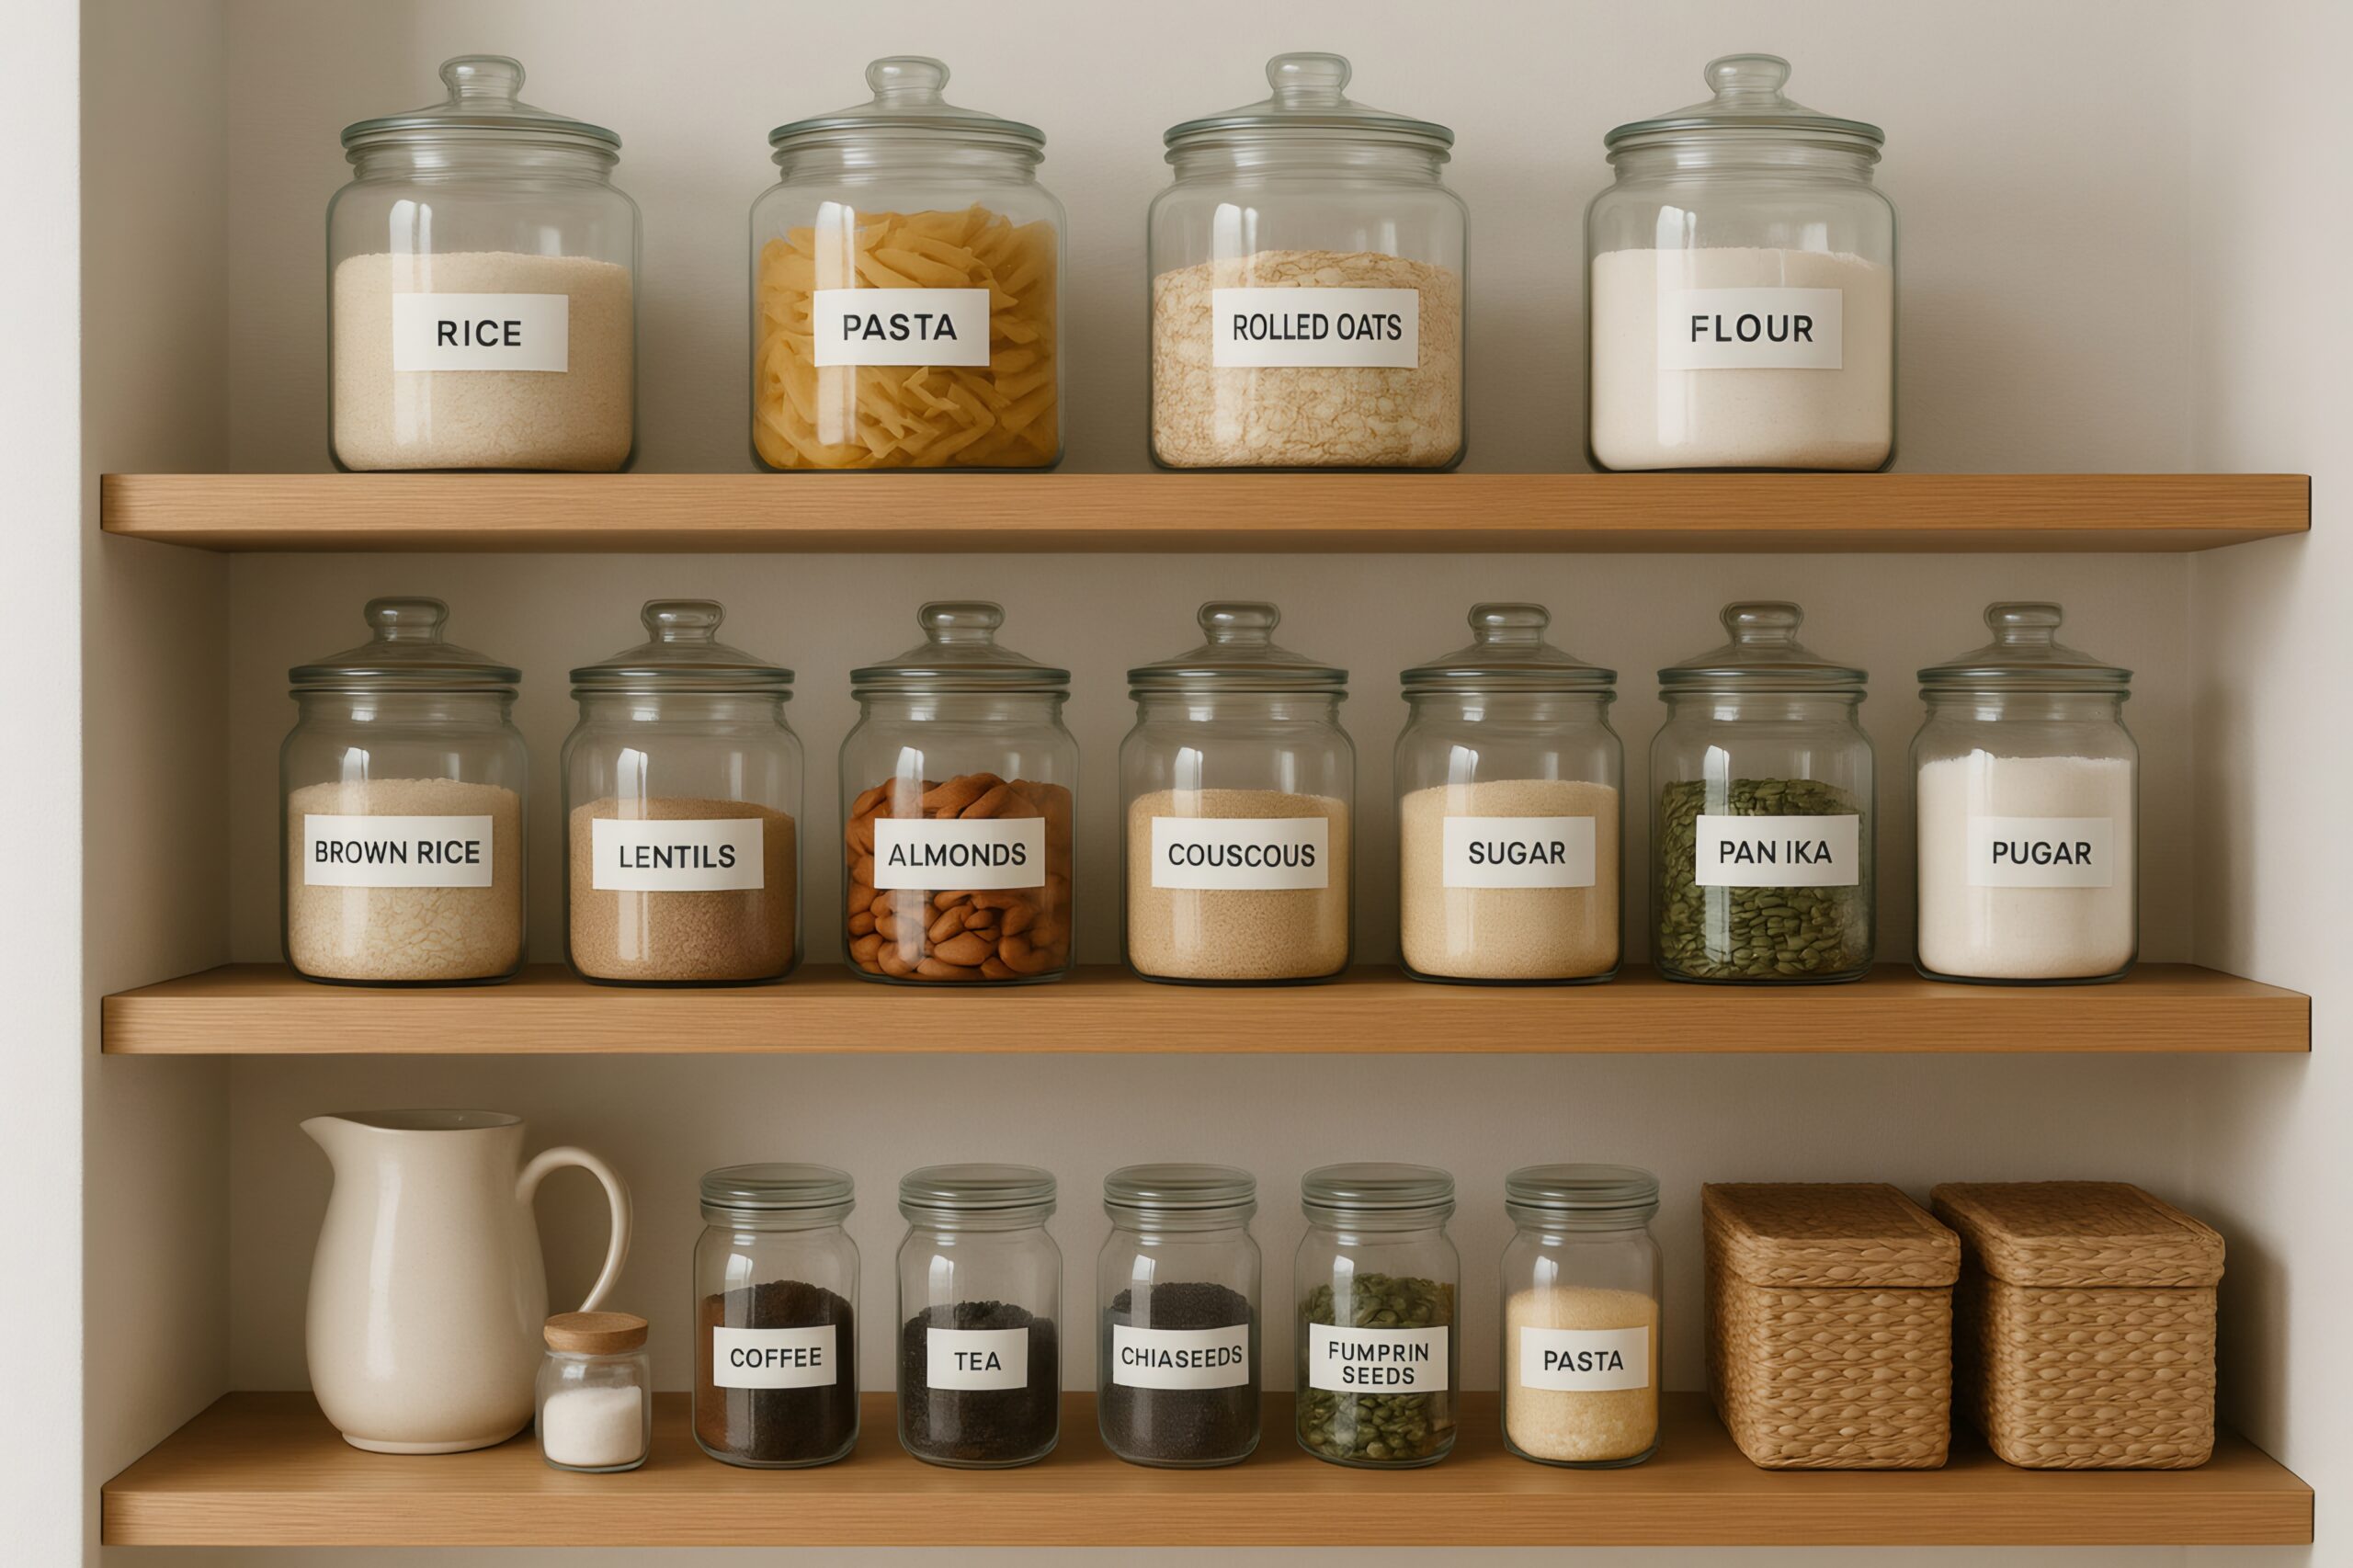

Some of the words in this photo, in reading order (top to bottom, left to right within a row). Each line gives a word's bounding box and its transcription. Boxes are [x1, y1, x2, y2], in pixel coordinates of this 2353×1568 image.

[438, 319, 522, 347] RICE
[843, 313, 958, 342] PASTA
[1233, 312, 1329, 341] ROLLED
[1336, 312, 1403, 341] OATS
[1691, 314, 1813, 343] FLOUR
[315, 840, 407, 864] BROWN
[417, 840, 481, 865] RICE
[619, 844, 736, 869] LENTILS
[888, 842, 1027, 868] ALMONDS
[1168, 843, 1316, 868] COUSCOUS
[1469, 840, 1566, 866] SUGAR
[1993, 841, 2092, 866] PUGAR
[730, 1346, 823, 1369] COFFEE
[953, 1351, 1002, 1371] TEA
[1329, 1341, 1429, 1362] FUMPRIN
[1544, 1349, 1624, 1372] PASTA
[1342, 1365, 1415, 1385] SEEDS
